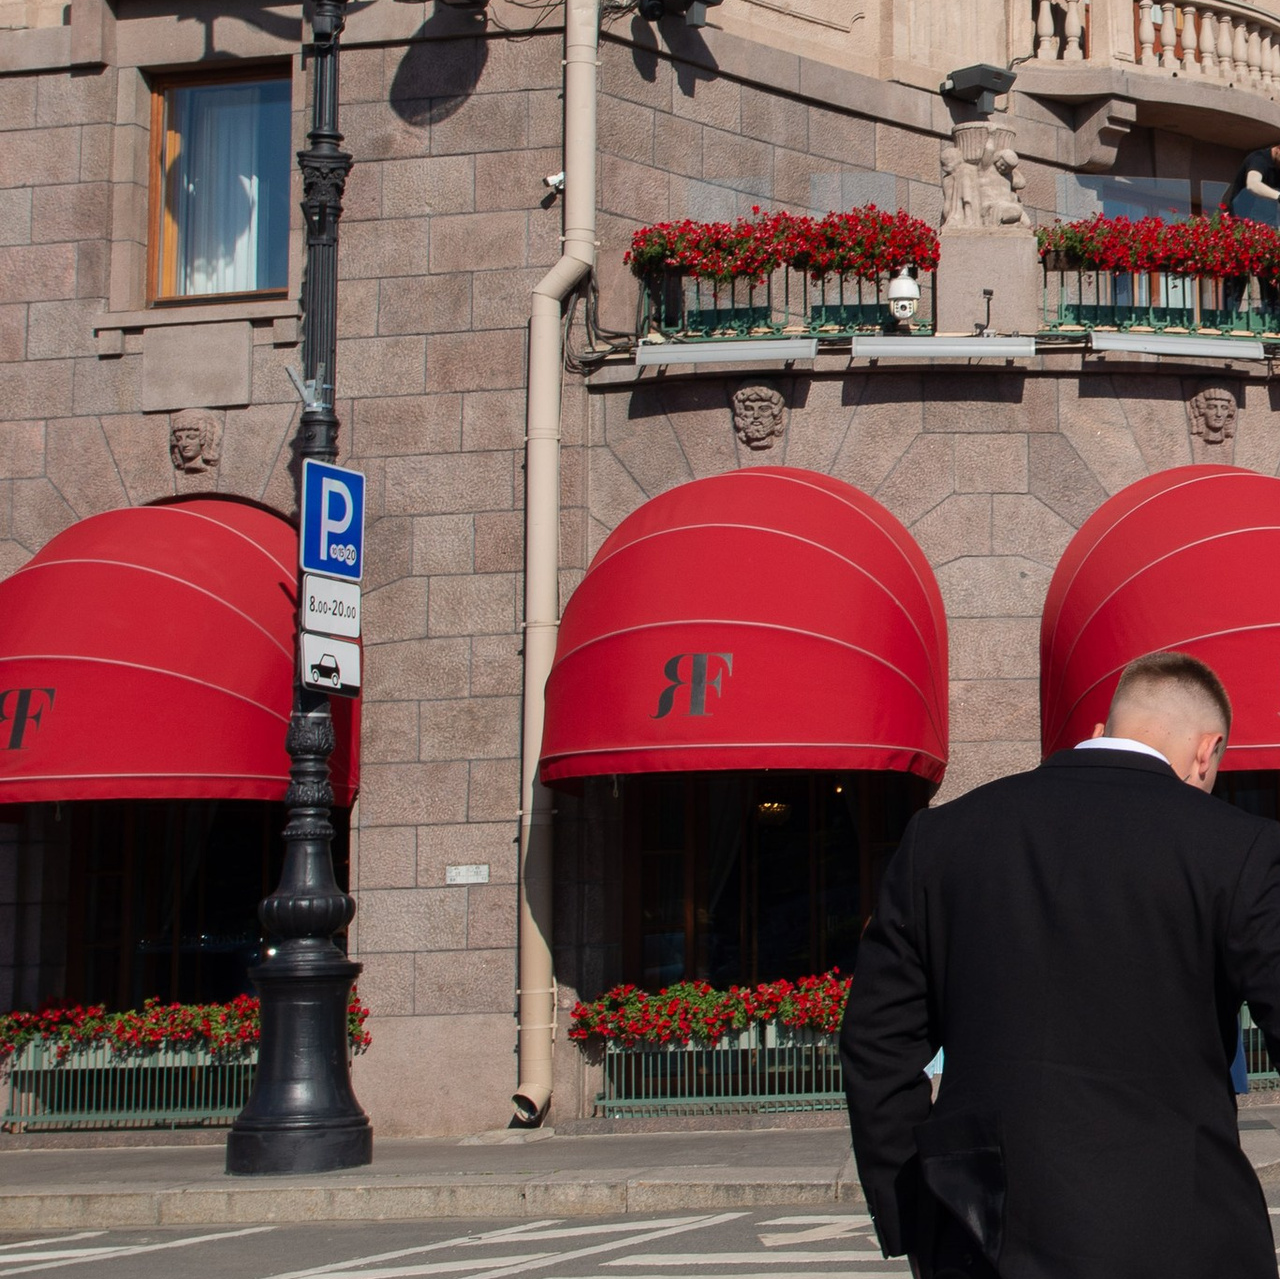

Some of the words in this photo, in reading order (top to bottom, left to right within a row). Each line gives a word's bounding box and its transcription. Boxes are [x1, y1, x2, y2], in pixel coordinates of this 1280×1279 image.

[319, 476, 354, 560] P
[346, 548, 356, 561] 20
[309, 595, 357, 619] 8.00-20.00
